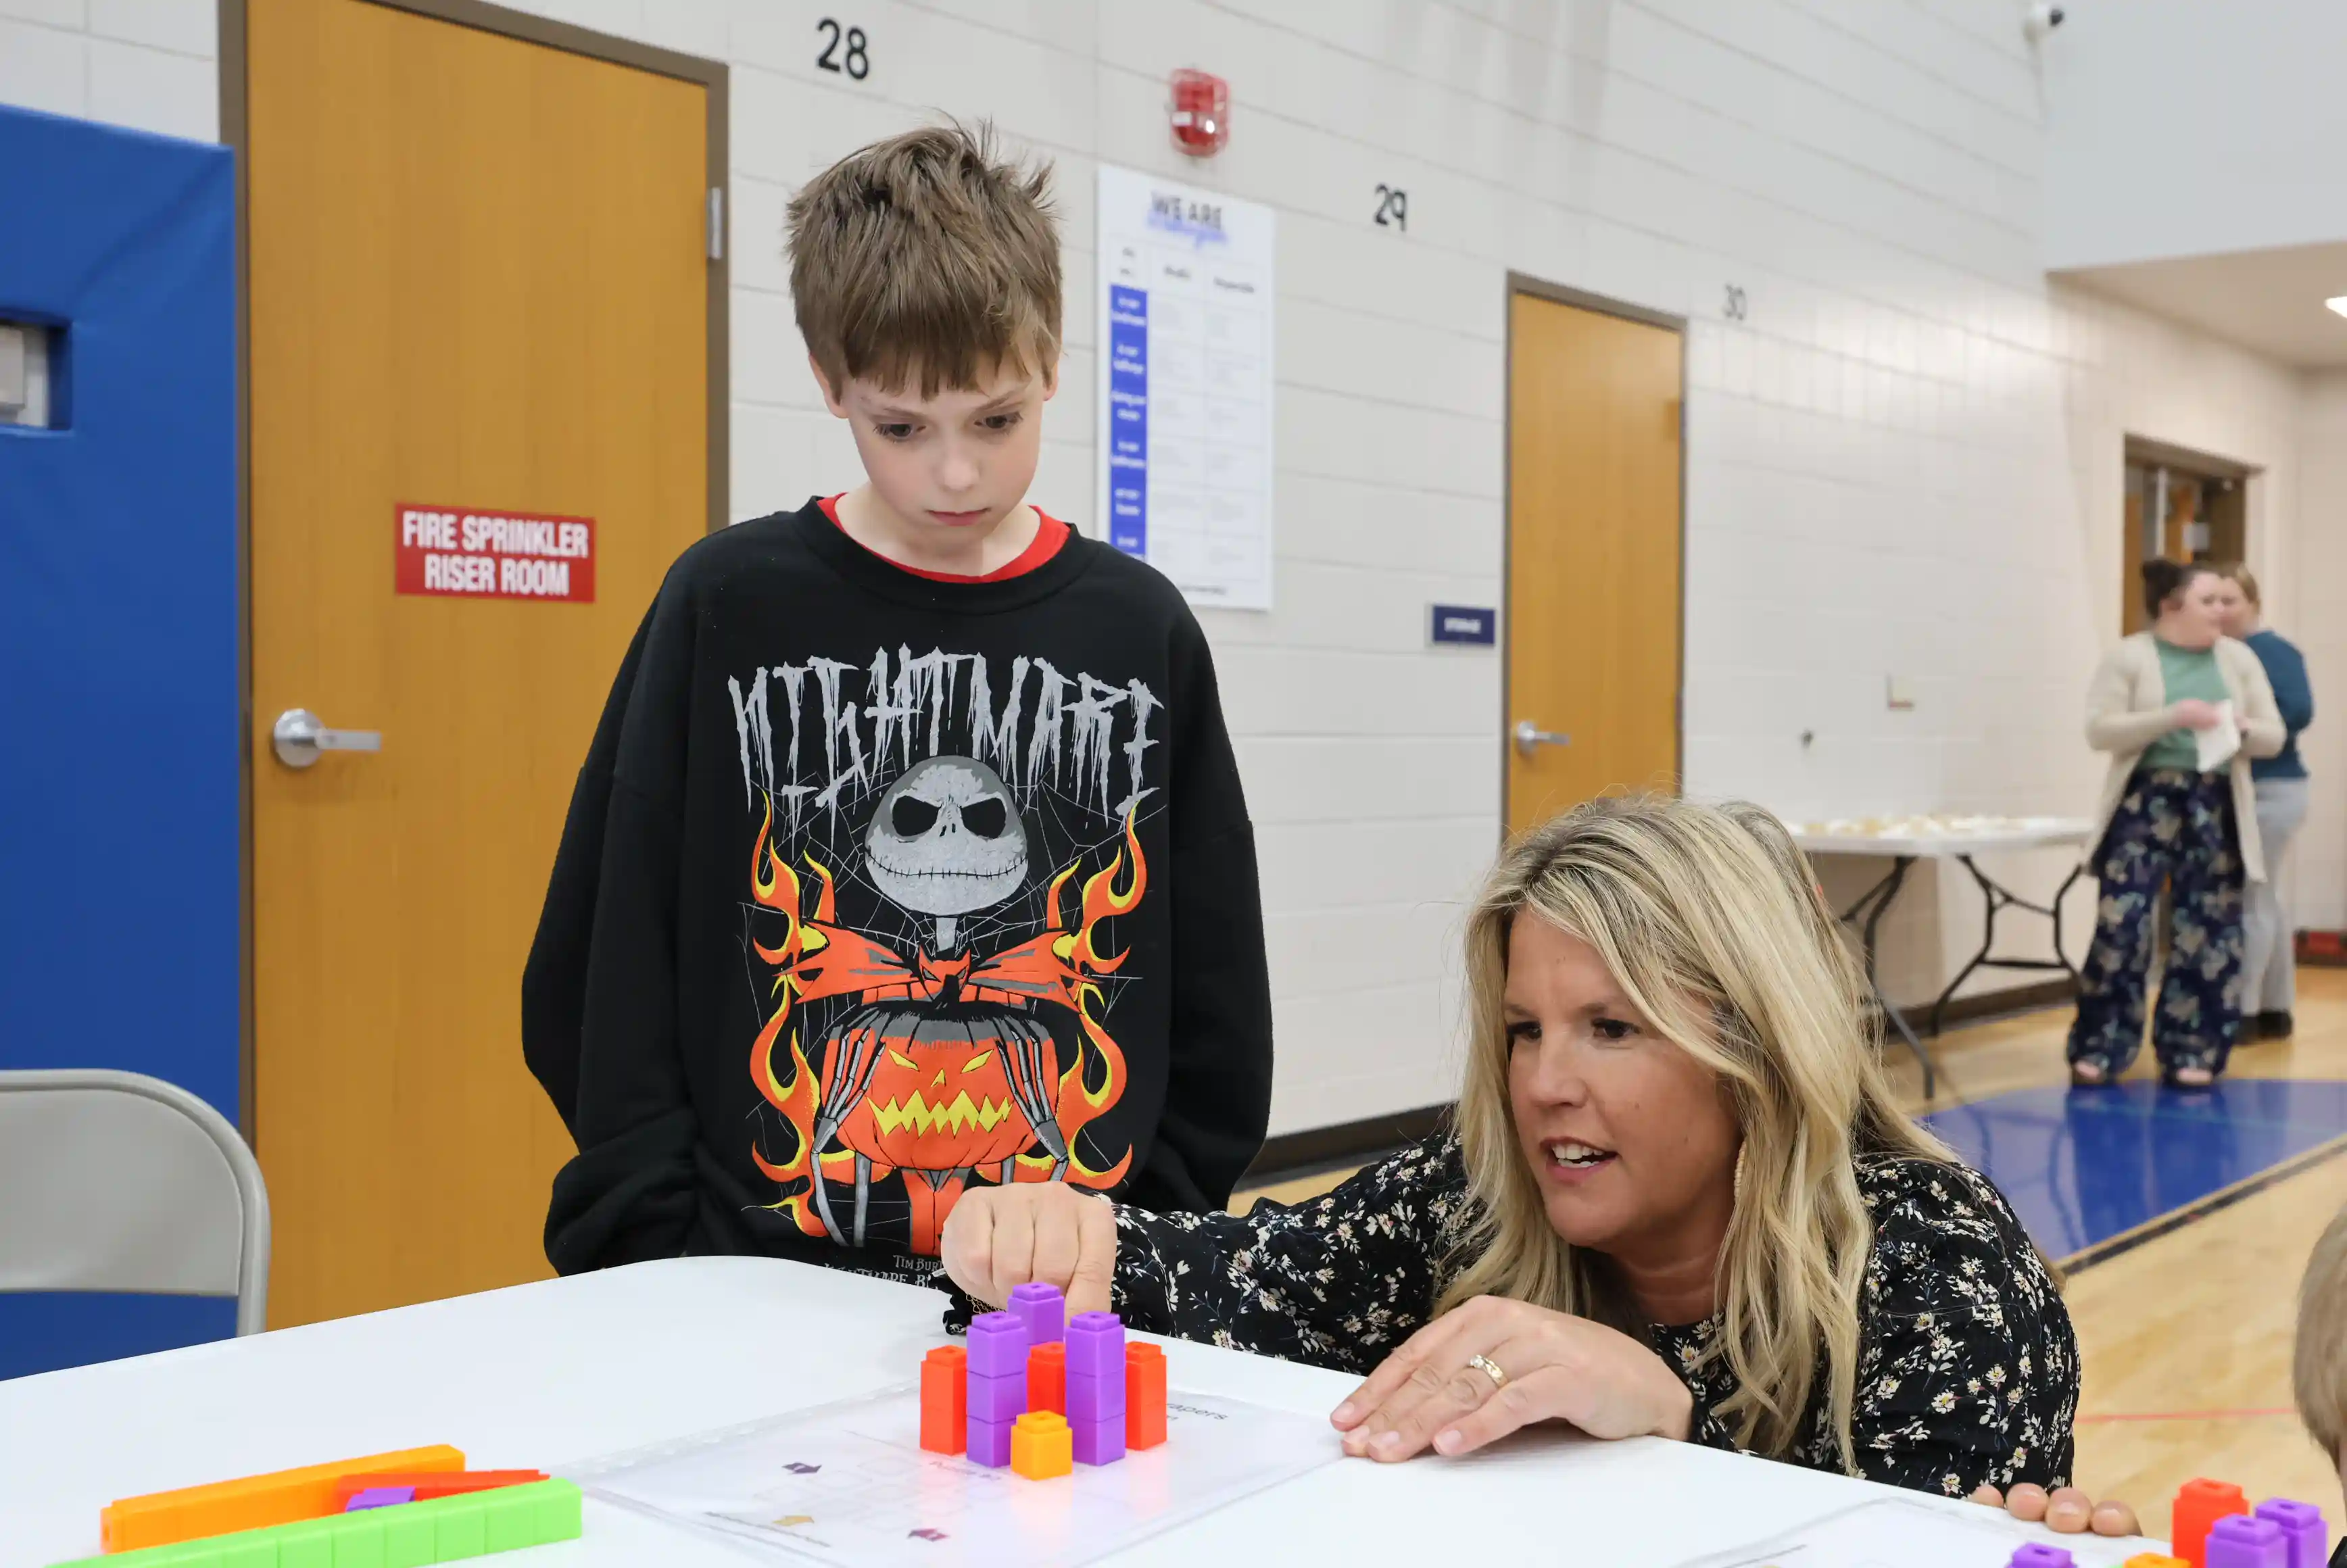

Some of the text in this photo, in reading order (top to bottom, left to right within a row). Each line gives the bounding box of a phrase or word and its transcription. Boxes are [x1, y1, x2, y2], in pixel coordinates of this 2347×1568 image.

[817, 18, 868, 80] 28
[1151, 191, 1221, 231] WE ARE
[1375, 183, 1407, 232] 29
[1724, 283, 1747, 320] 30
[403, 510, 589, 558] FIRE SPRINKLER
[425, 553, 570, 597] RISER ROOM
[893, 1254, 914, 1270] TIM
